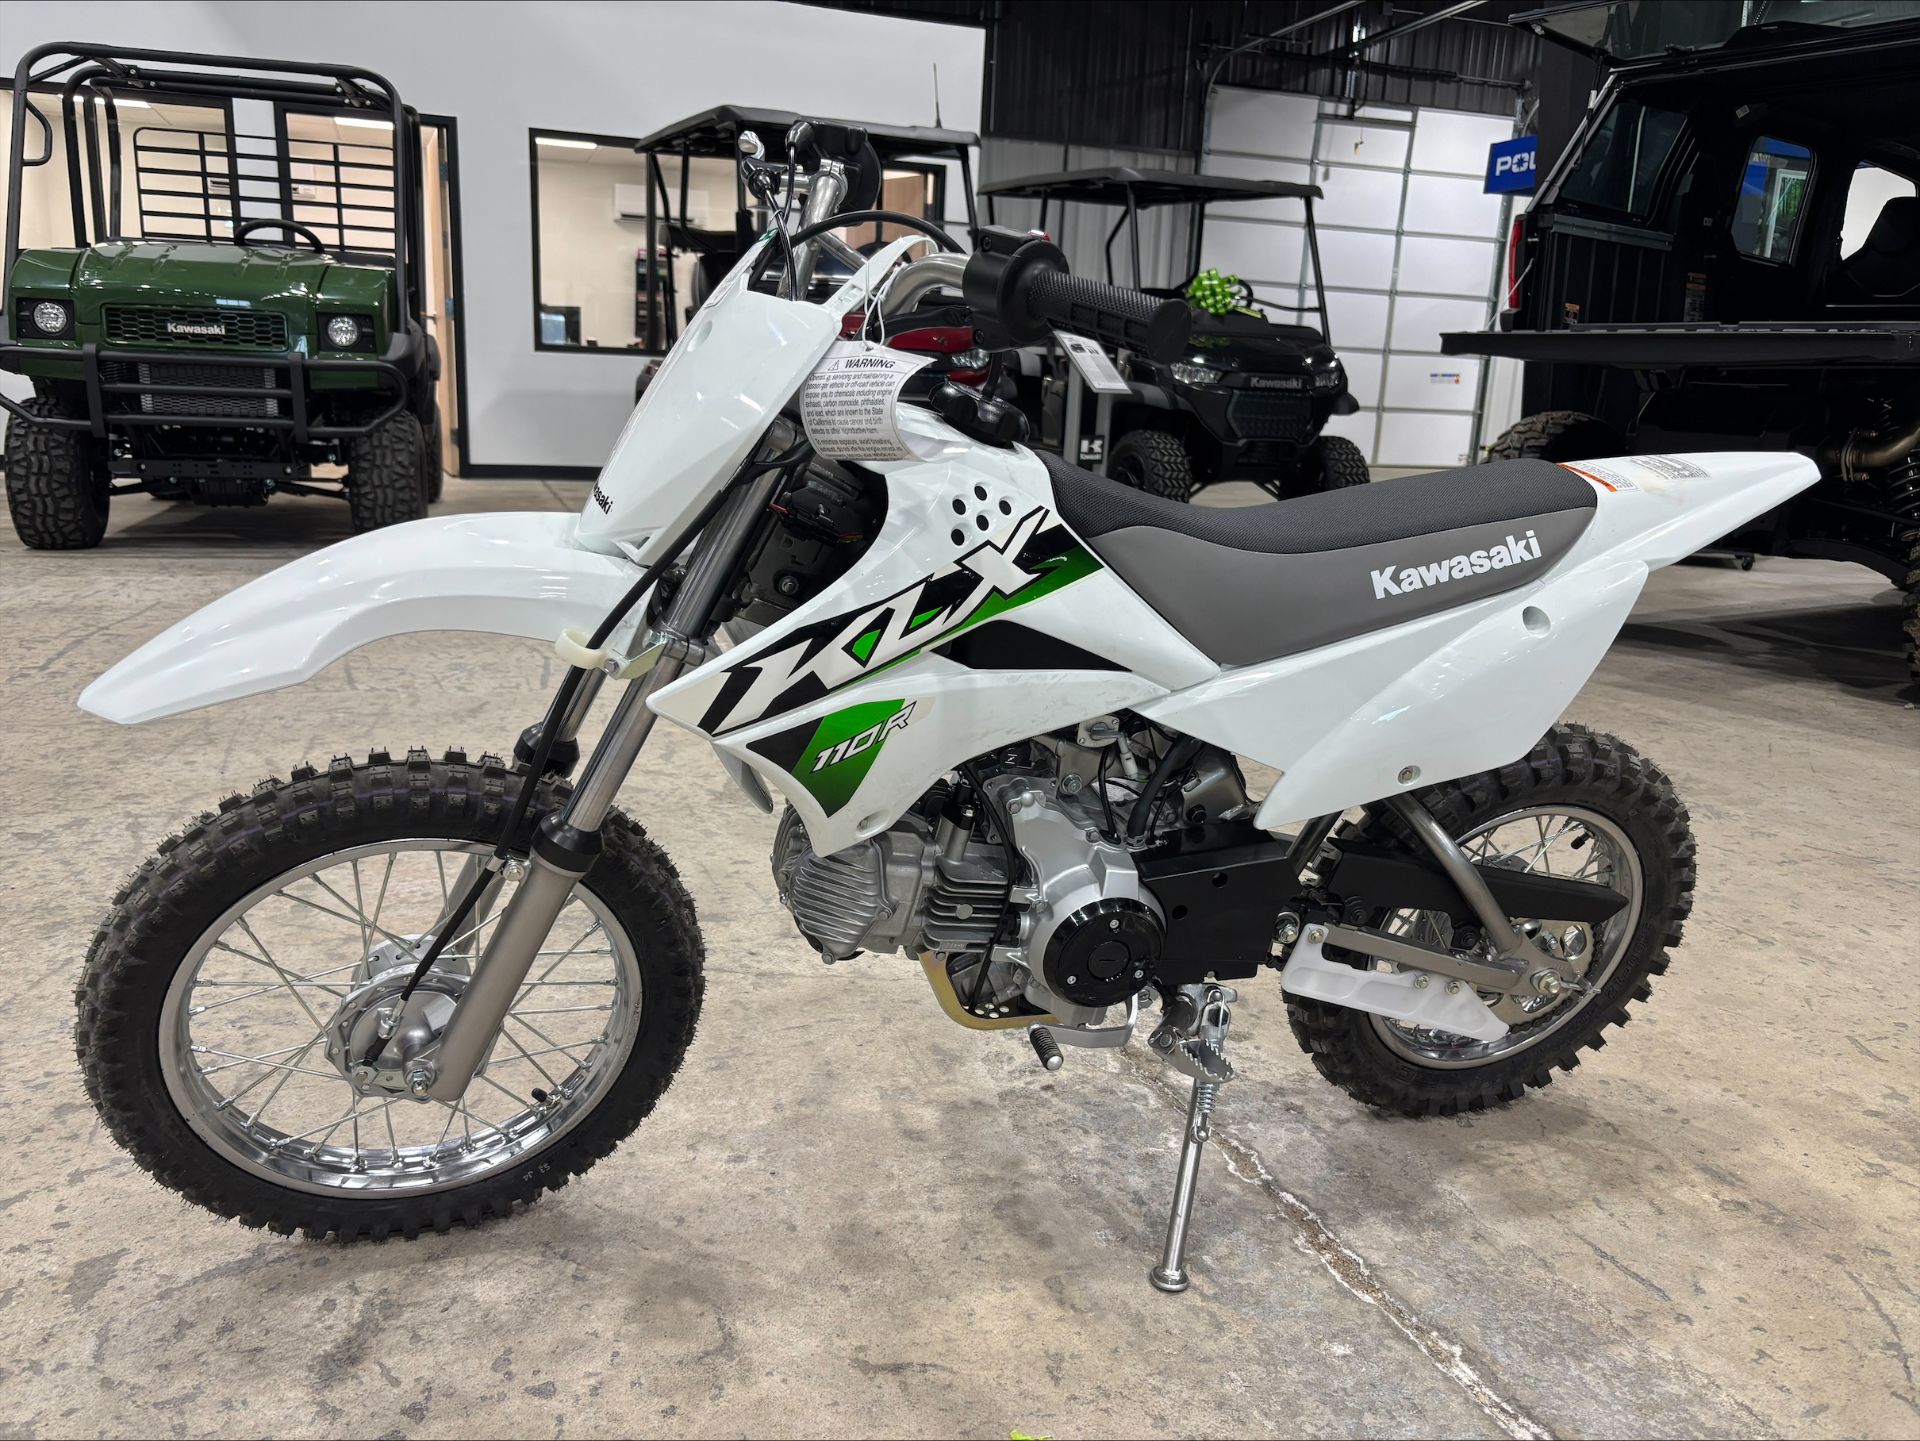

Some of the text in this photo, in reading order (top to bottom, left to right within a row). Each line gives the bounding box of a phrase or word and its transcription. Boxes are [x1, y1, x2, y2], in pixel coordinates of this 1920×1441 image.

[167, 322, 227, 335] Kawasaki
[844, 358, 896, 369] WARNING
[1249, 376, 1303, 390] Kawasaki
[1370, 529, 1542, 600] Kawasaki
[704, 506, 1048, 737] KLX
[810, 700, 917, 774] 110R
